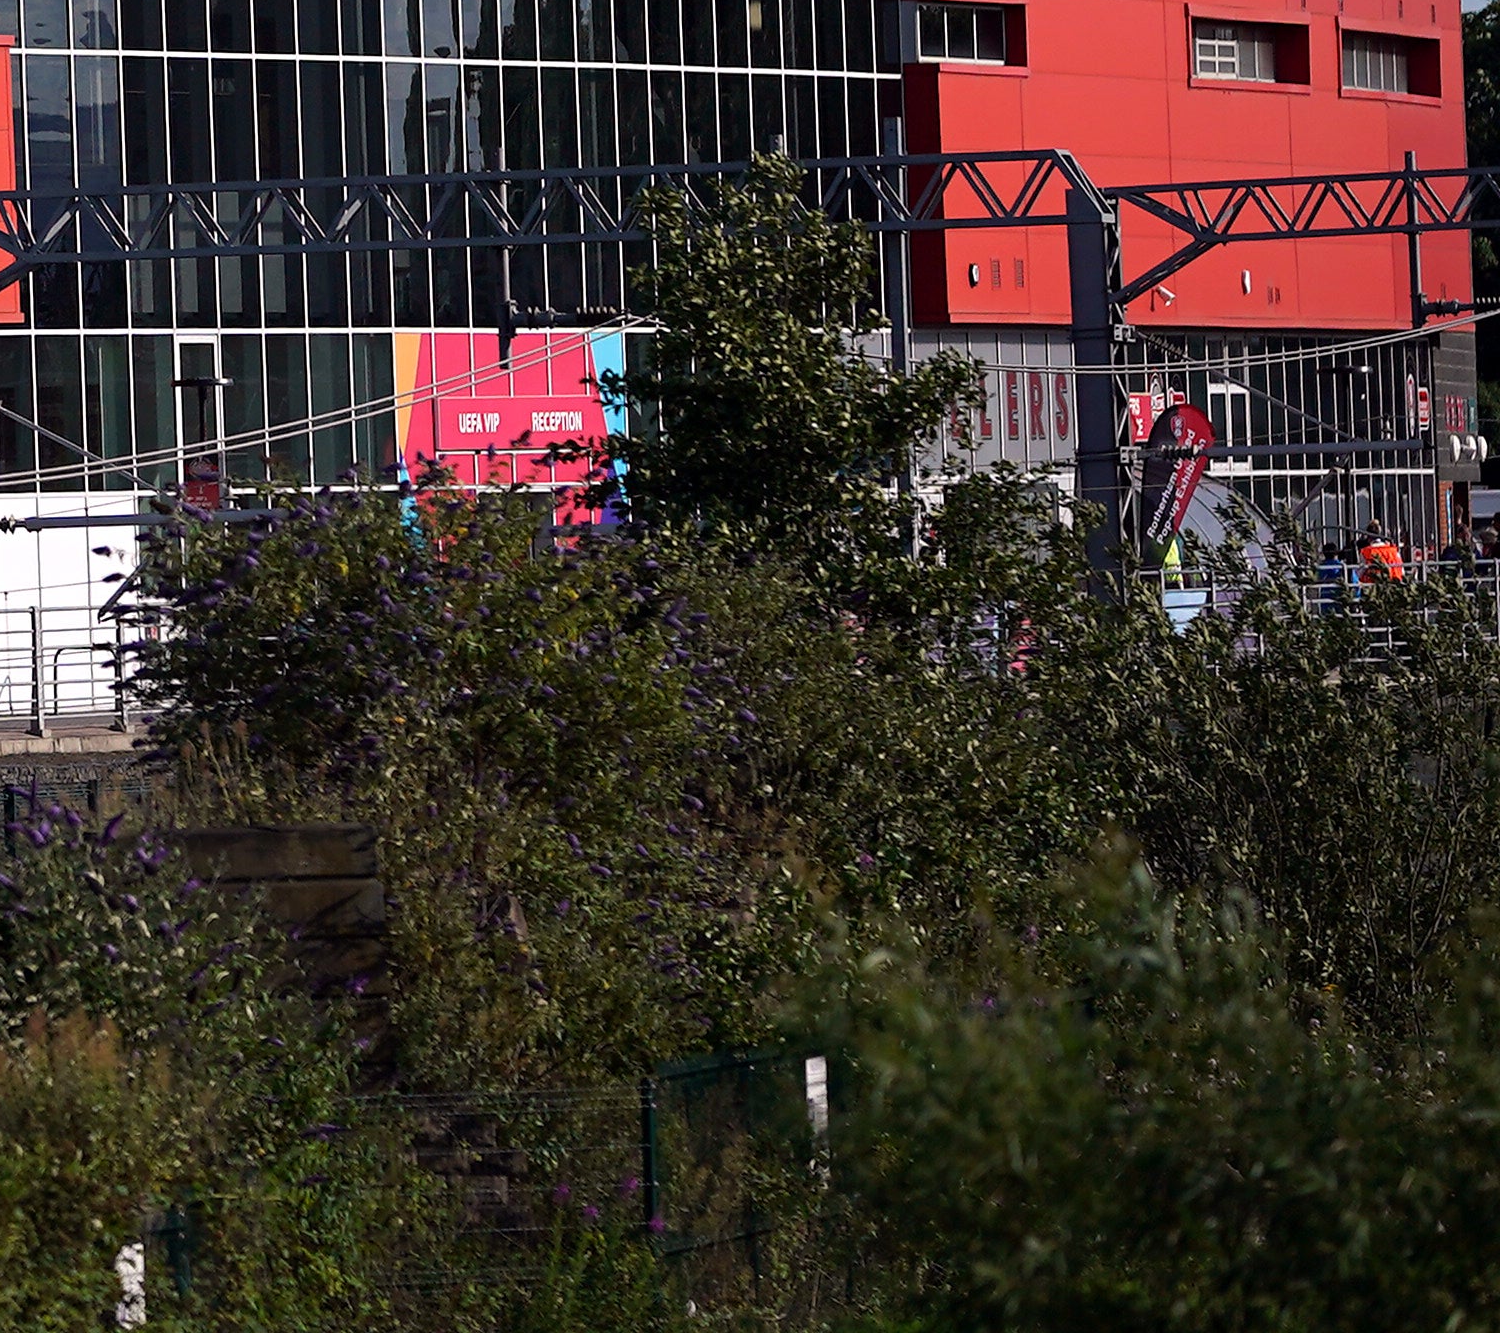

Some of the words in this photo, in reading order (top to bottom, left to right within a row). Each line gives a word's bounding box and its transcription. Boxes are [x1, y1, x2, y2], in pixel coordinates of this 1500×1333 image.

[458, 412, 484, 433] UEFA
[483, 412, 501, 433] VIP
[531, 411, 583, 432] RECEPTION
[1147, 470, 1179, 539] Rotherham
[1156, 500, 1181, 546] Pop-up
